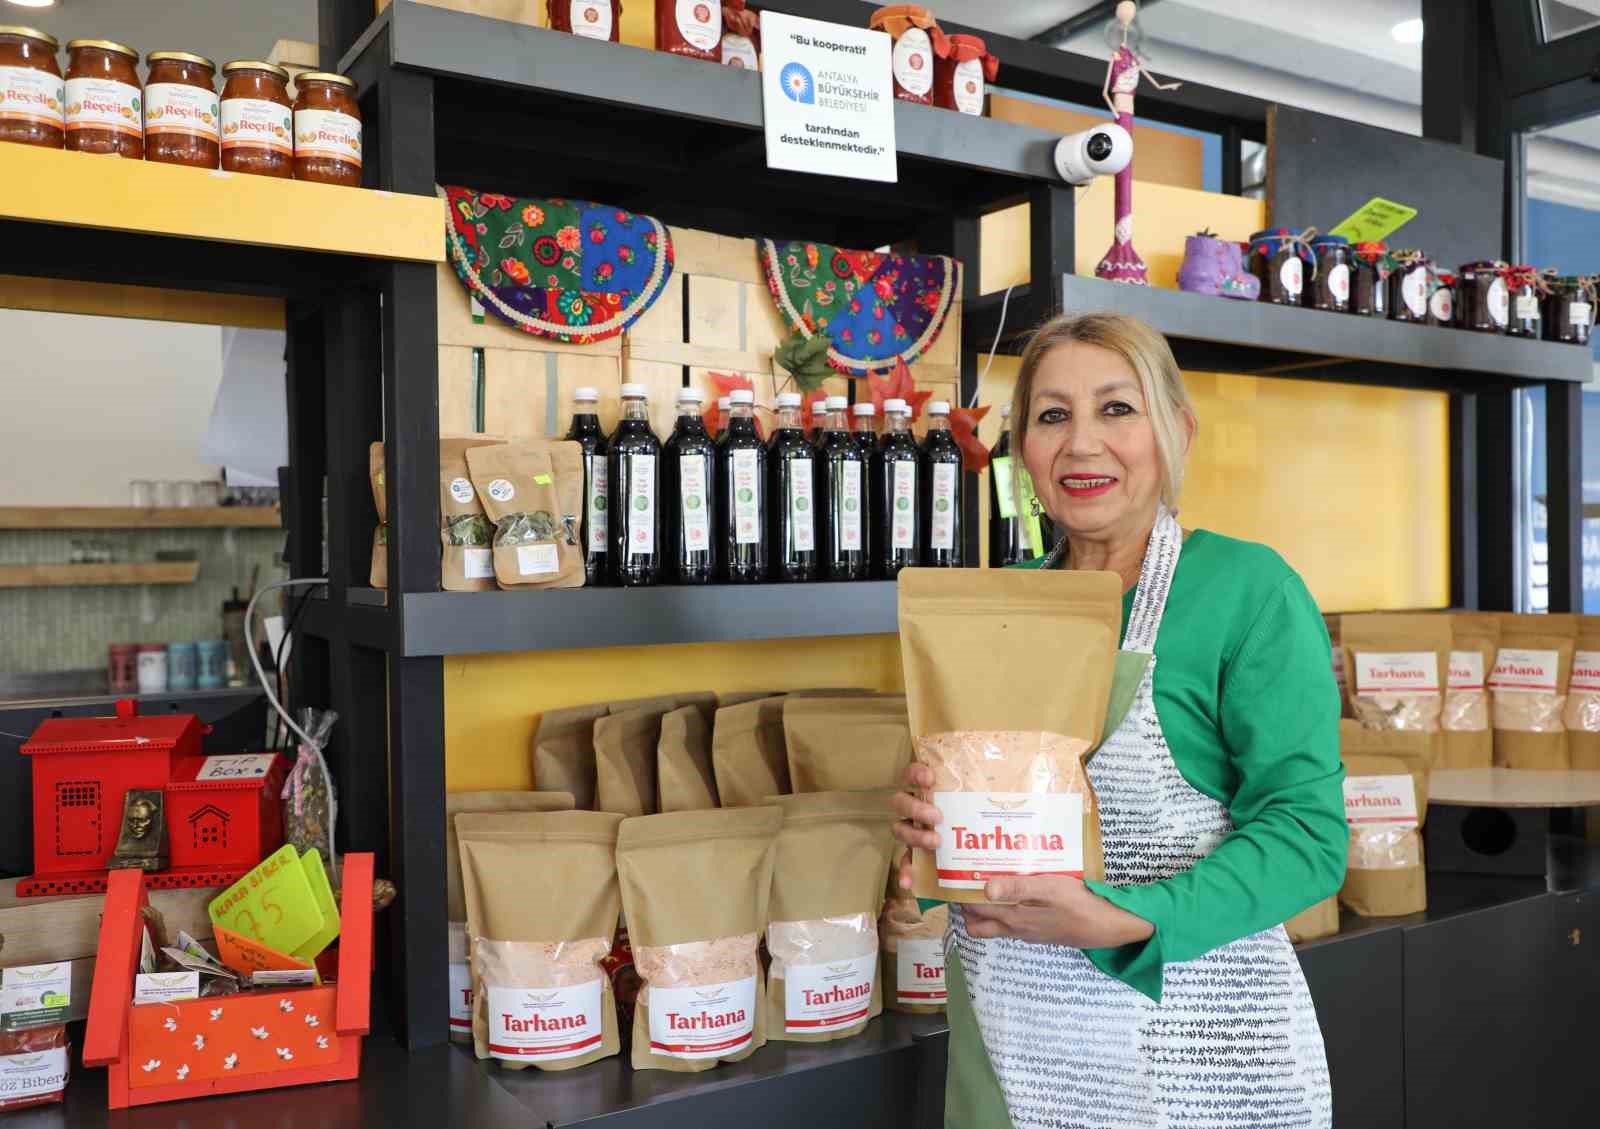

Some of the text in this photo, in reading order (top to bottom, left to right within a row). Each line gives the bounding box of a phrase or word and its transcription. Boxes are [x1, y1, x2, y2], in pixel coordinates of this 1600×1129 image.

[813, 37, 867, 55] kooperatif
[817, 70, 859, 84] ANTALYA
[805, 123, 860, 139] tarafından
[1369, 667, 1426, 679] Tarhana
[951, 825, 1064, 850] Tarhana
[801, 982, 871, 1006] Tarhana
[502, 1013, 587, 1032] Tarhana
[665, 1008, 745, 1029] Tarhana
[23, 1074, 63, 1089] Biber
